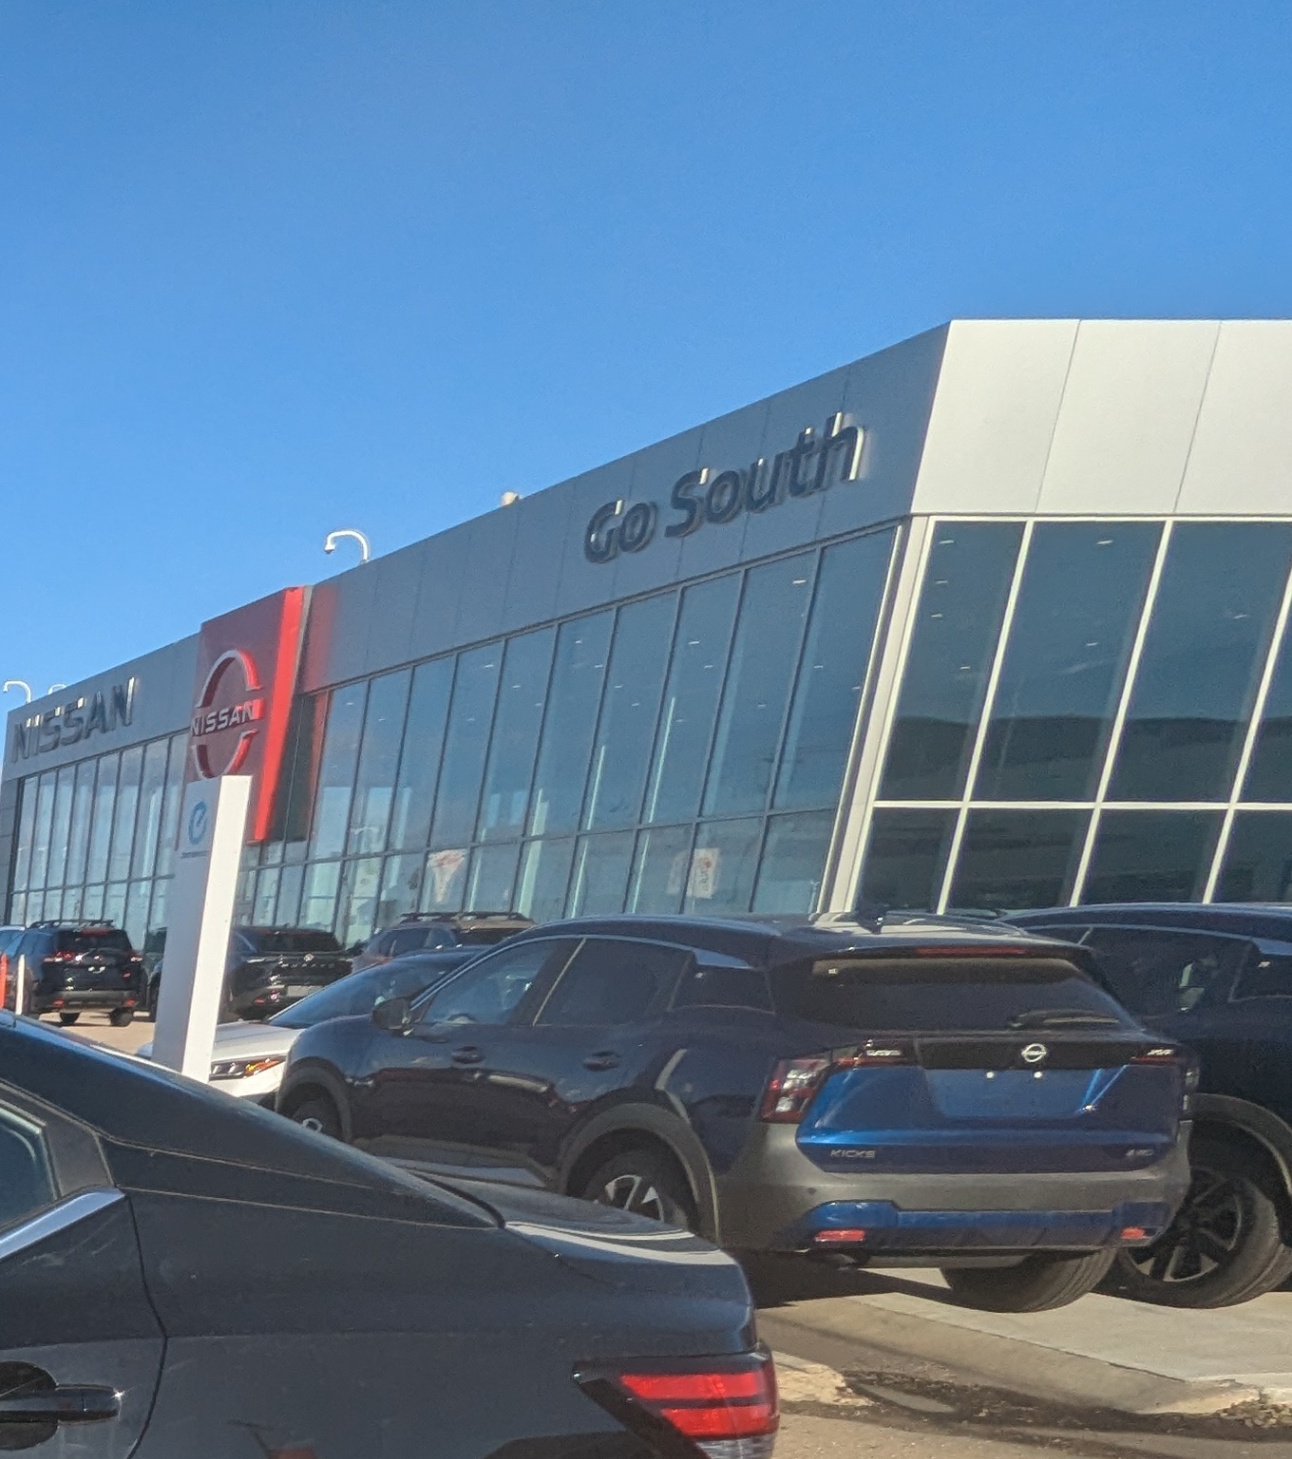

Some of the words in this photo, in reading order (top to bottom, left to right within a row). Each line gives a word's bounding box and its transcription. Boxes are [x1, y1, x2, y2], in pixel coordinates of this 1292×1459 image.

[584, 499, 656, 564] Go
[665, 410, 866, 538] South
[12, 676, 136, 763] NISSAN
[190, 699, 264, 737] NISSAN
